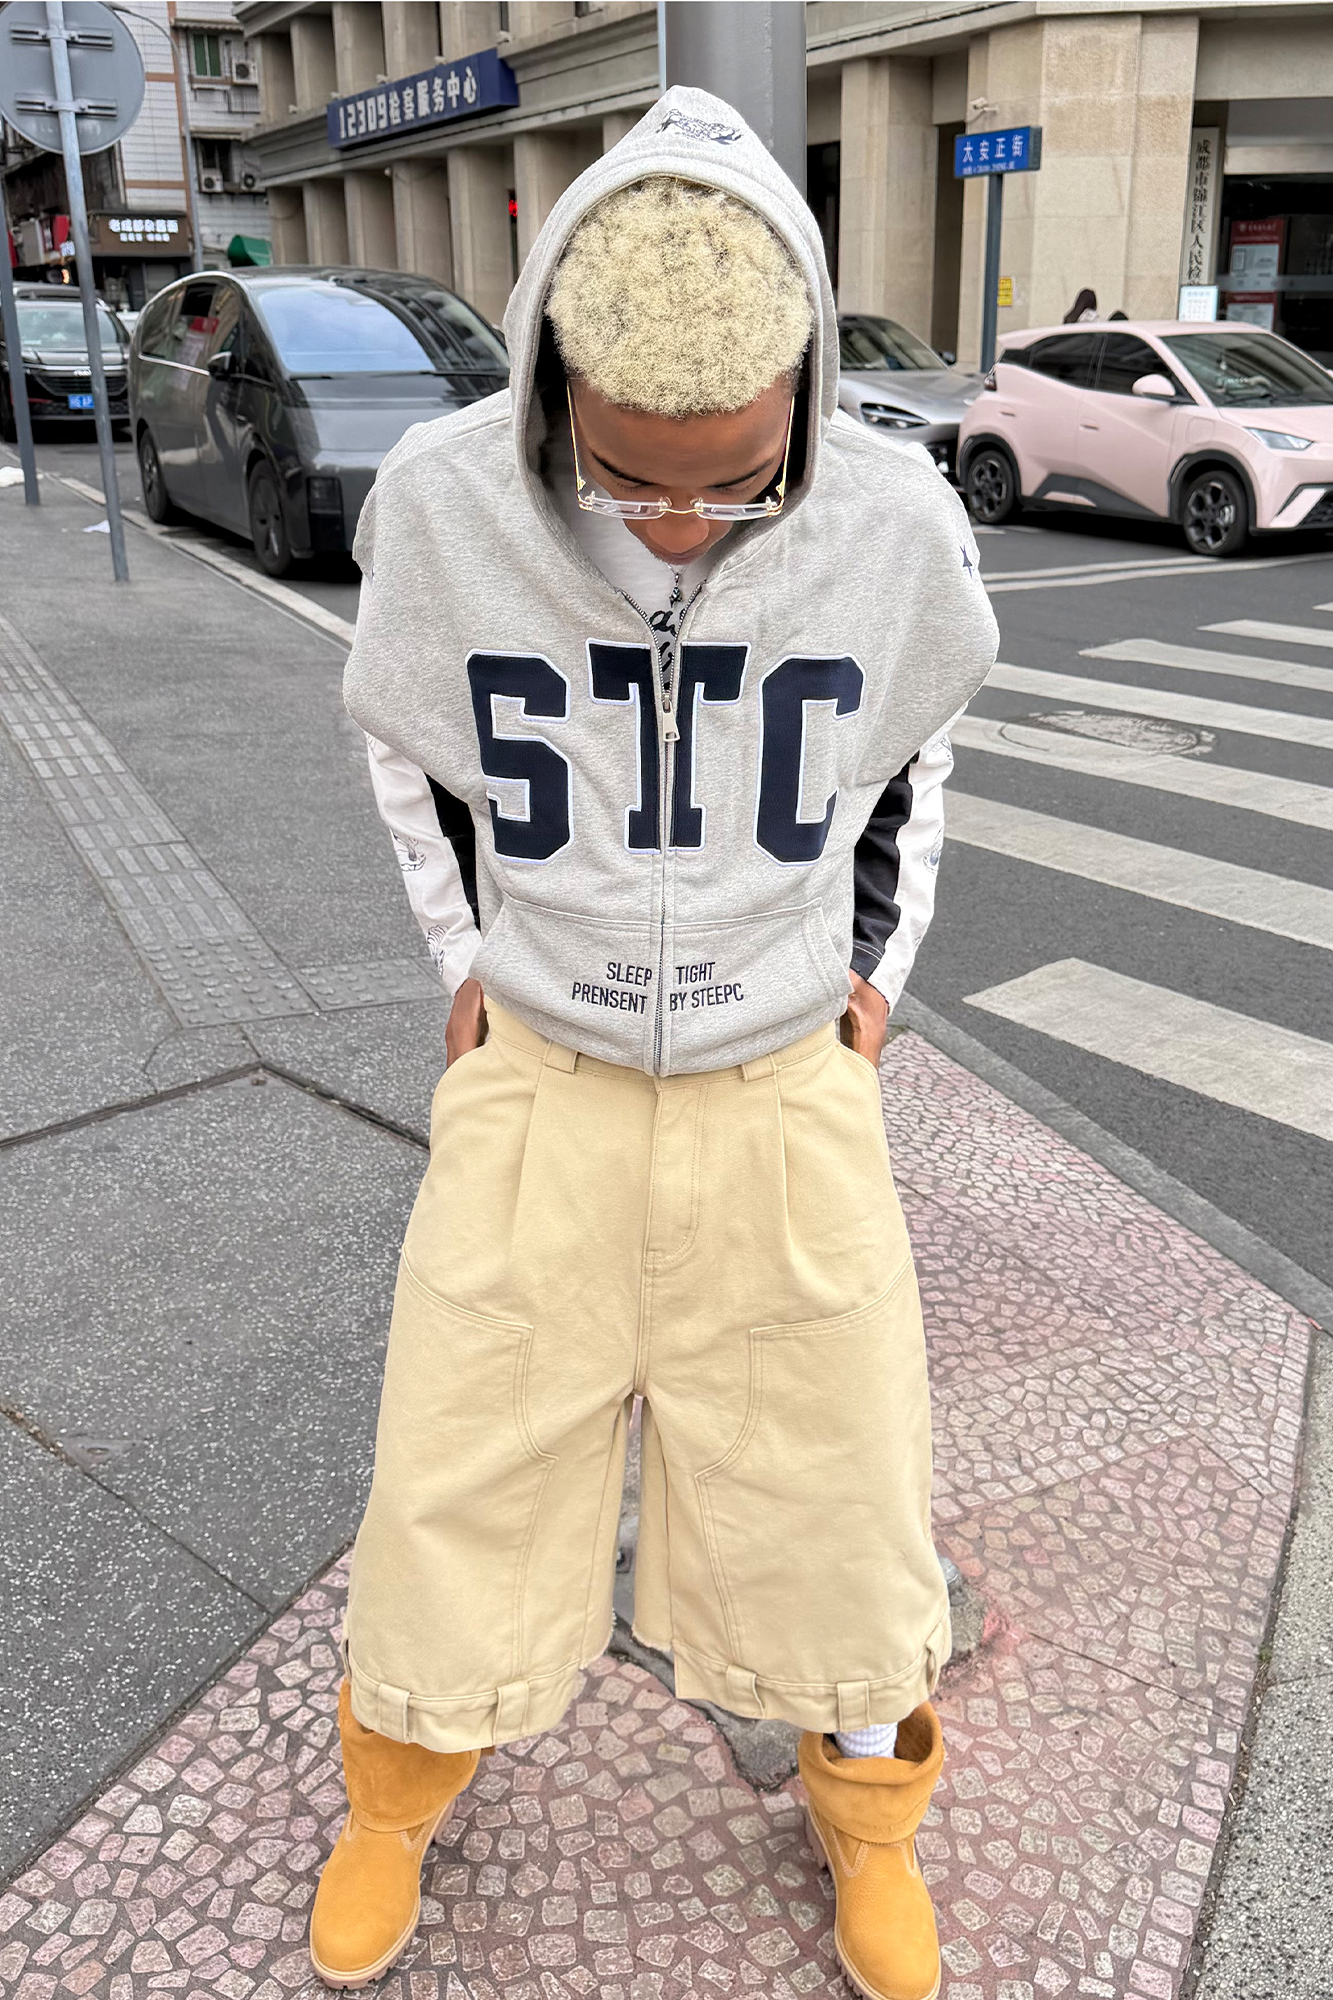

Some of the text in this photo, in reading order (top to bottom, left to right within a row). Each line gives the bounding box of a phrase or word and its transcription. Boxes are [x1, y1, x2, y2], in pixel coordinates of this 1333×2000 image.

[339, 66, 477, 140] 12309检察服务中心
[963, 134, 1023, 162] 大安正街
[465, 637, 866, 866] STC
[607, 962, 716, 987] SLEEP TIGHT
[572, 981, 744, 1014] PRENSENT BY STEEPC
